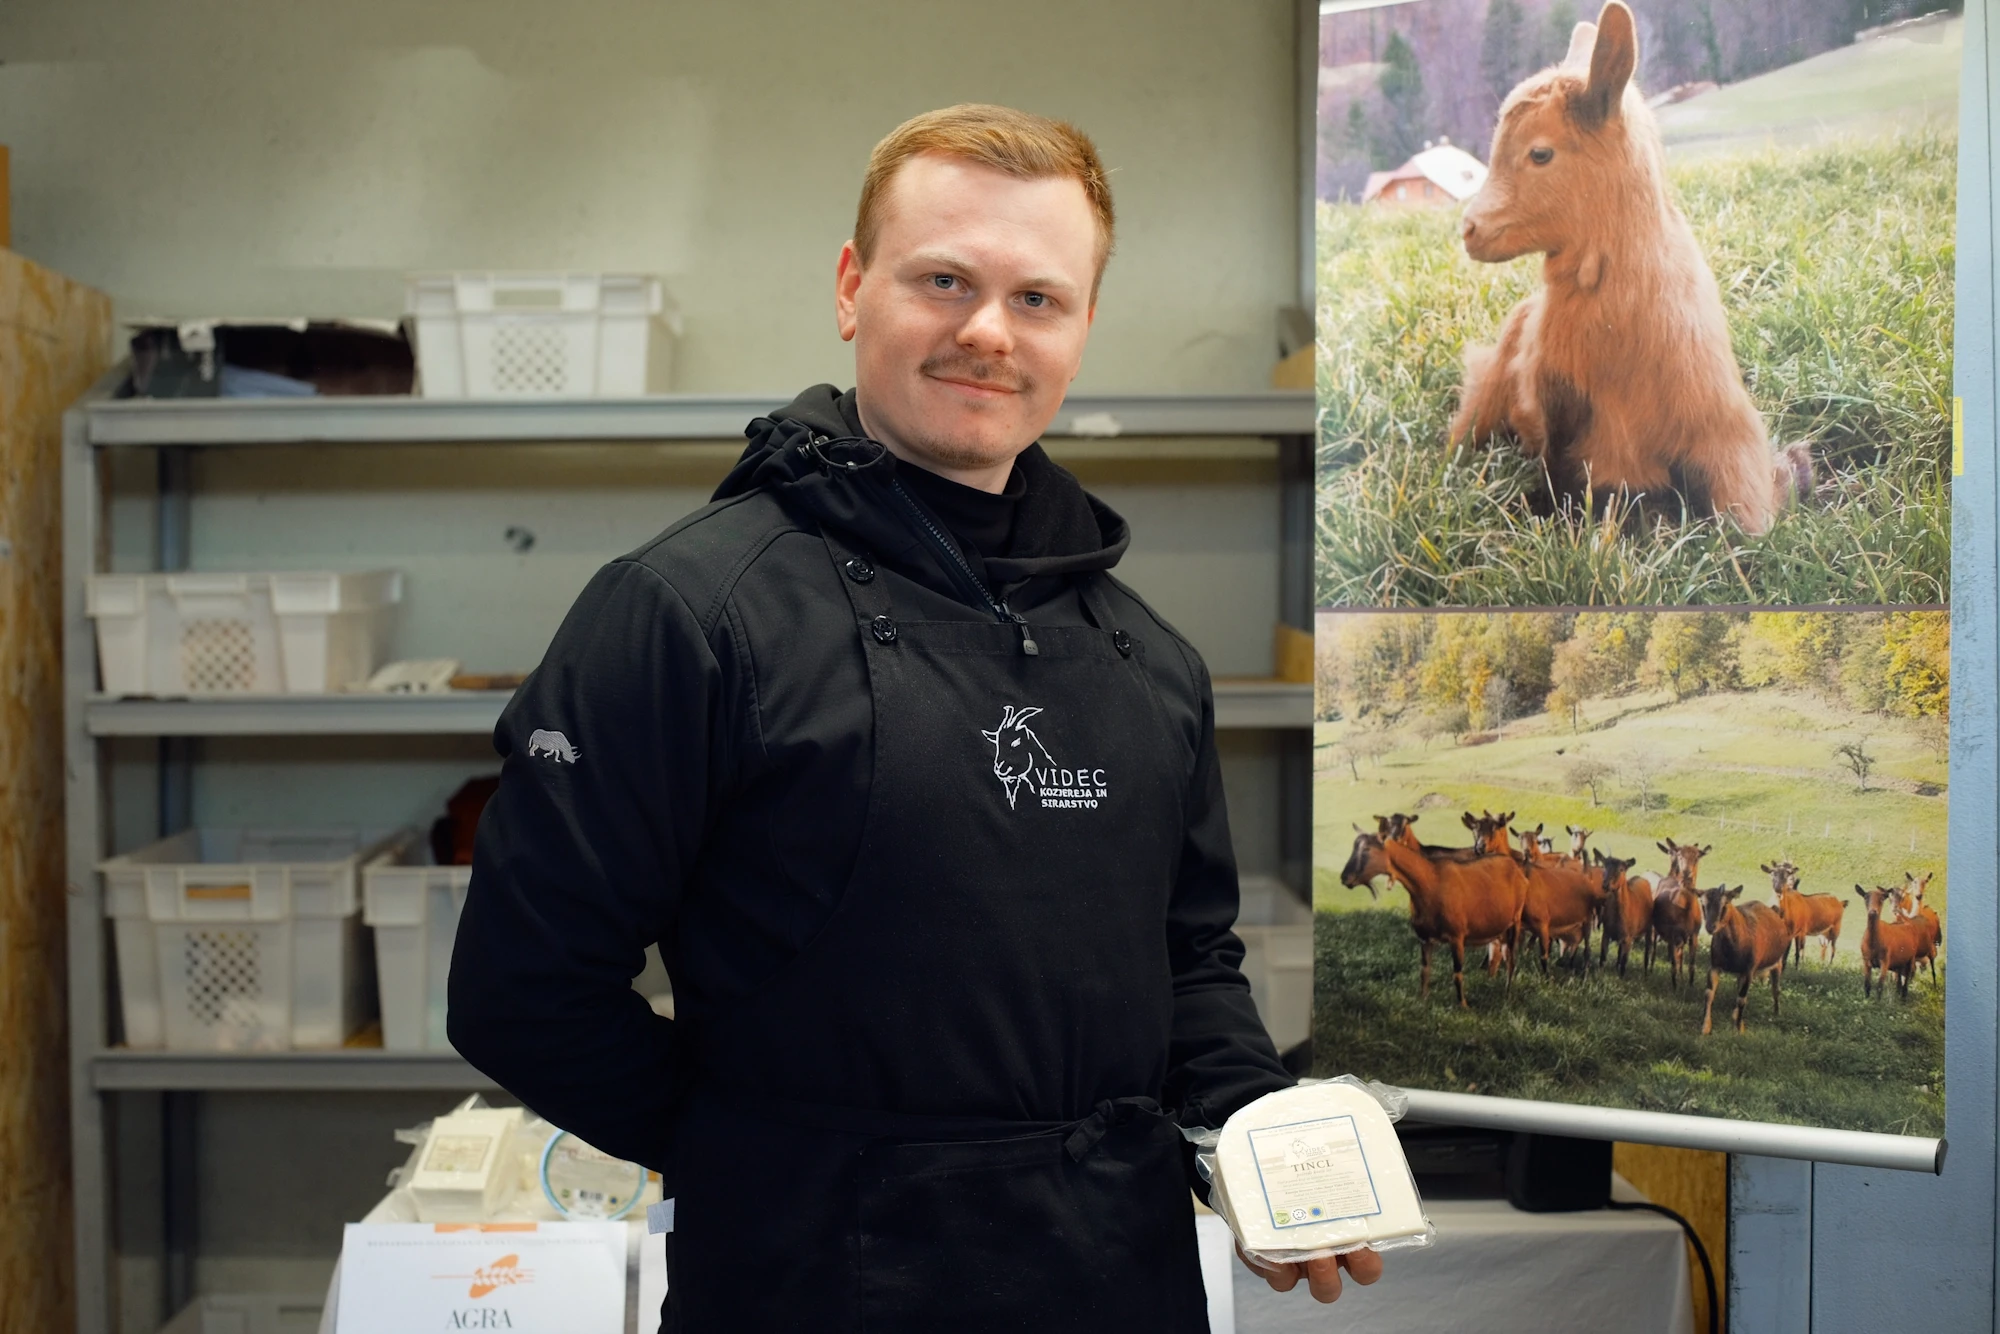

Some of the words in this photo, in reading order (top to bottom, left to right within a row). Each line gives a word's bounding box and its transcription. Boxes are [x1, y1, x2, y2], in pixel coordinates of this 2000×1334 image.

[1035, 767, 1107, 786] VIDEC
[1039, 787, 1093, 797] KOZJEREJA
[1095, 788, 1108, 797] IN
[1041, 799, 1098, 809] SIRARSTVO
[1290, 1159, 1334, 1172] TINCL
[445, 1307, 514, 1330] AGRA
